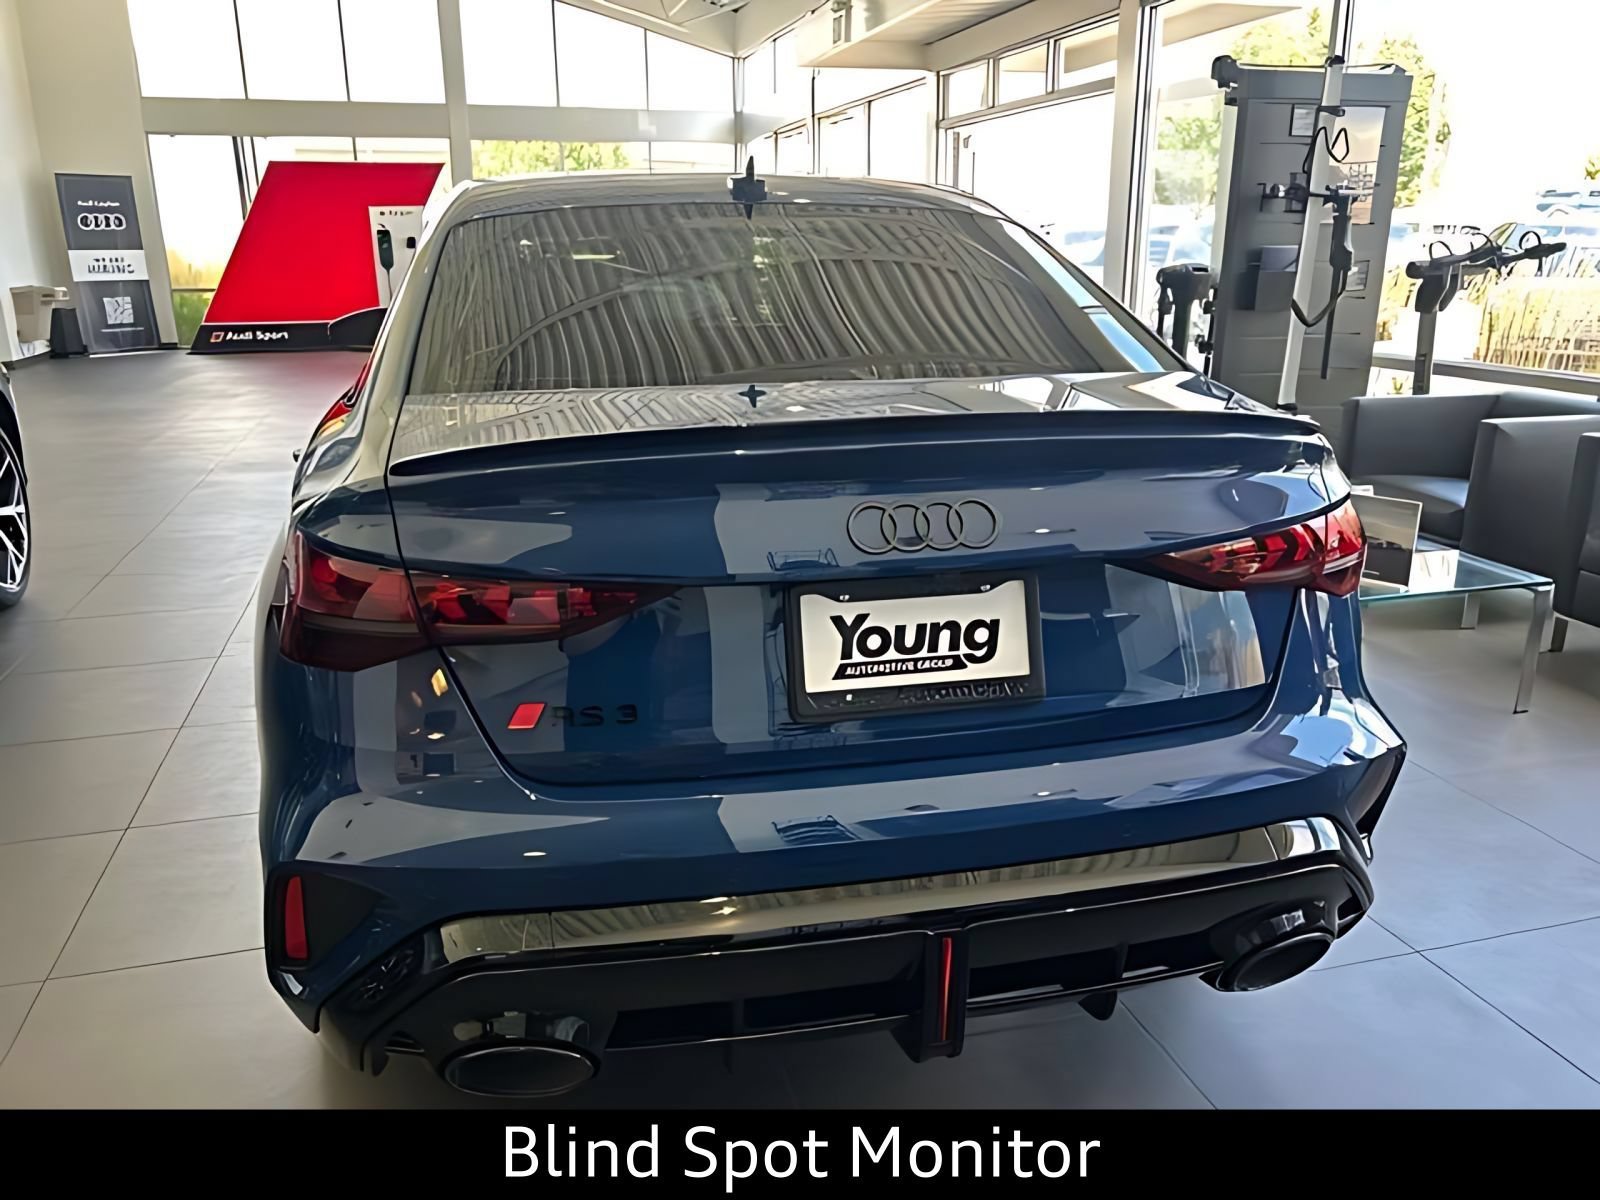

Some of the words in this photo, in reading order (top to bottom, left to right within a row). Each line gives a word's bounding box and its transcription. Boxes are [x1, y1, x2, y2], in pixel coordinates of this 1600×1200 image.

[830, 613, 1001, 664] Young
[549, 704, 605, 728] RS
[615, 703, 638, 725] 3
